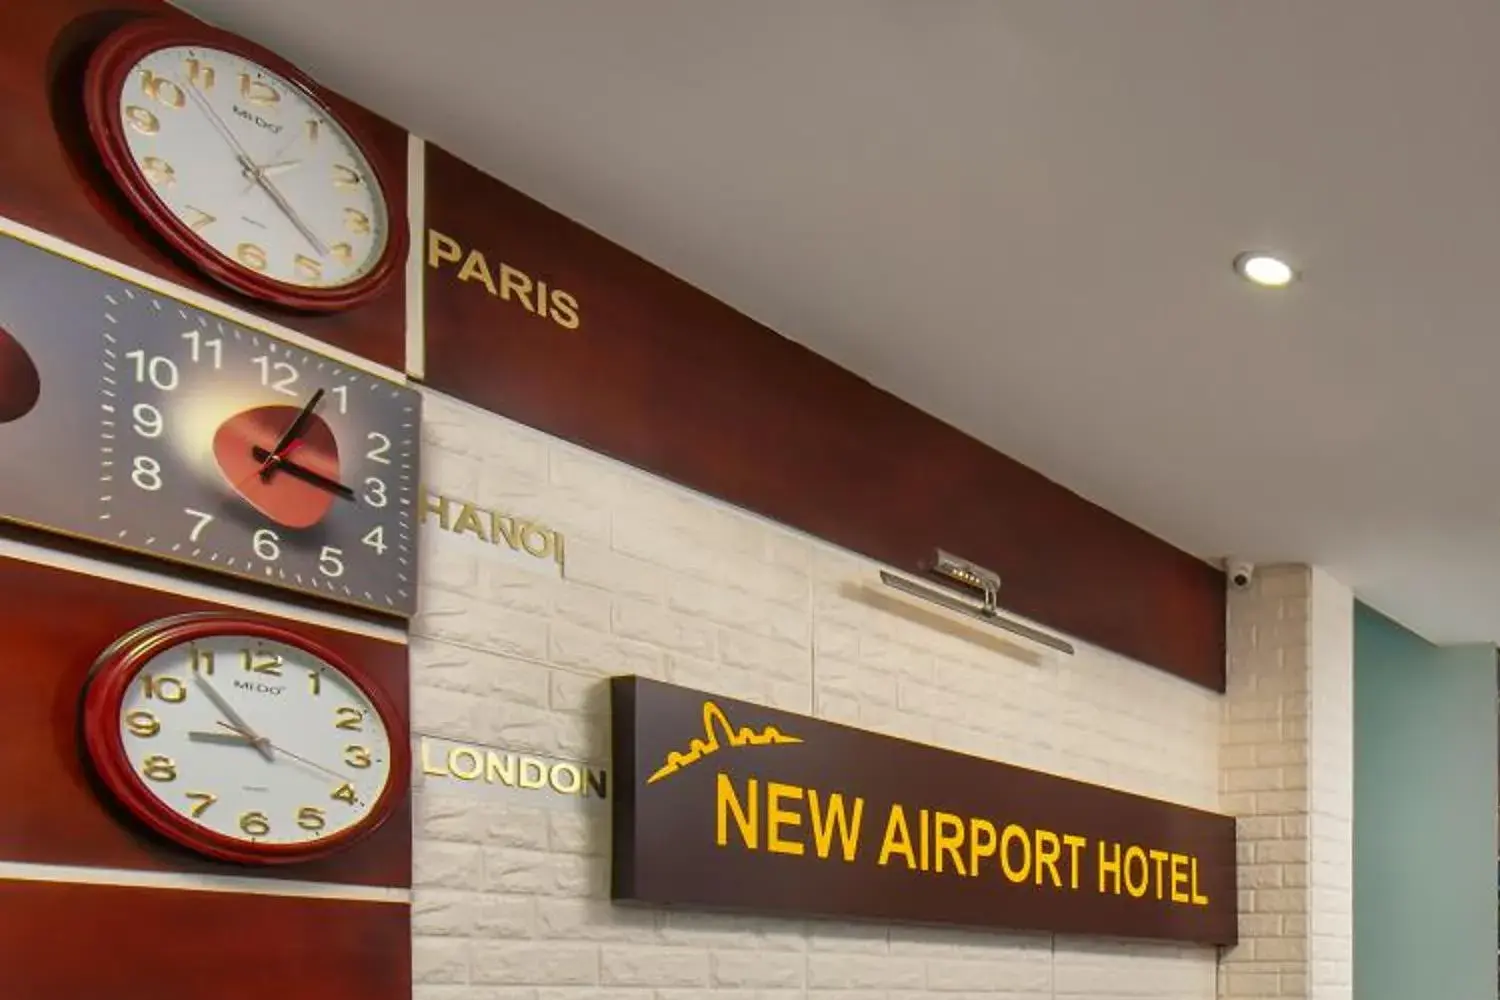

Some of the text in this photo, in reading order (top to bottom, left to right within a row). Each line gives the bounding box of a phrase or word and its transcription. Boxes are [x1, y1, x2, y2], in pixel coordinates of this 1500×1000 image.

[139, 69, 185, 107] 10
[185, 59, 214, 89] 11
[125, 105, 160, 133] 9
[306, 119, 318, 140] 1
[184, 204, 216, 227] 7
[237, 243, 266, 269] 6
[428, 228, 579, 330] PARIS
[182, 330, 222, 369] 11
[126, 350, 179, 391] 10
[252, 355, 299, 396] 12
[332, 385, 347, 414] 1
[133, 404, 162, 437] 9
[365, 432, 392, 465] 2
[131, 456, 162, 491] 8
[363, 477, 387, 507] 3
[184, 507, 215, 542] 7
[418, 481, 565, 567] HANOI
[253, 529, 280, 561] 6
[361, 526, 387, 555] 4
[319, 546, 344, 577] 5
[189, 646, 214, 676] 11
[240, 649, 283, 676] 12
[140, 674, 187, 703] 10
[308, 671, 320, 695] 1
[126, 711, 160, 738] 9
[335, 707, 363, 731] 2
[143, 755, 176, 782] 8
[344, 745, 371, 769] 3
[421, 736, 607, 798] LONDON
[185, 792, 217, 817] 7
[330, 782, 358, 805] 4
[240, 812, 269, 836] 6
[297, 807, 325, 830] 5
[716, 772, 1208, 904] NEW AIRPORT HOTEL
